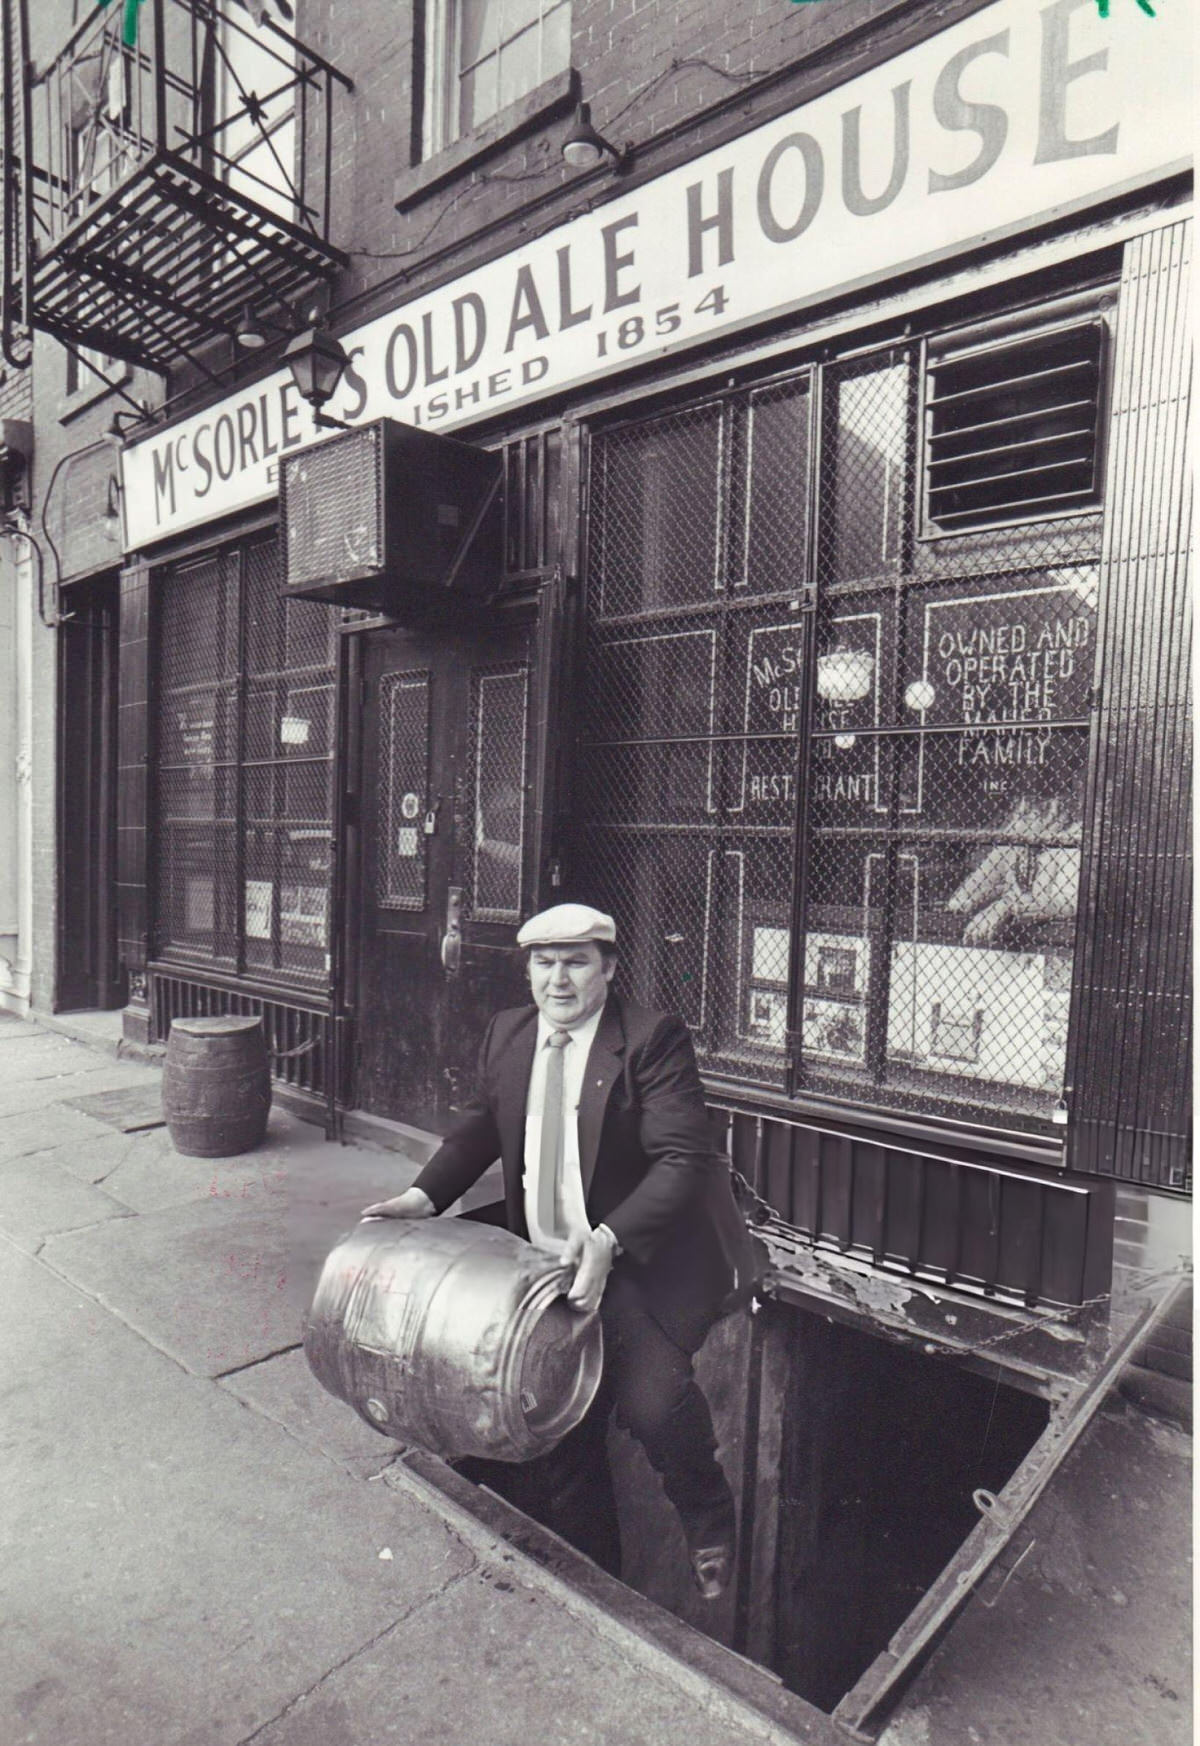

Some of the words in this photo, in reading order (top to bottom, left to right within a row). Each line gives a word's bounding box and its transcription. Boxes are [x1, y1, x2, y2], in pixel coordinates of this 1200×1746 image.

[152, 345, 368, 526] McSORLES
[384, 291, 487, 400] OLD
[503, 211, 642, 354] ALE
[686, 0, 1120, 279] HOUSE
[596, 284, 730, 358] 1854
[938, 624, 1026, 659] OWNED
[1037, 616, 1090, 649] AND
[945, 649, 1075, 686] OPERATED
[962, 681, 992, 711] BY
[1008, 679, 1058, 709] THE
[957, 735, 1052, 766] FAMILY
[750, 774, 876, 801] RESTRANT
